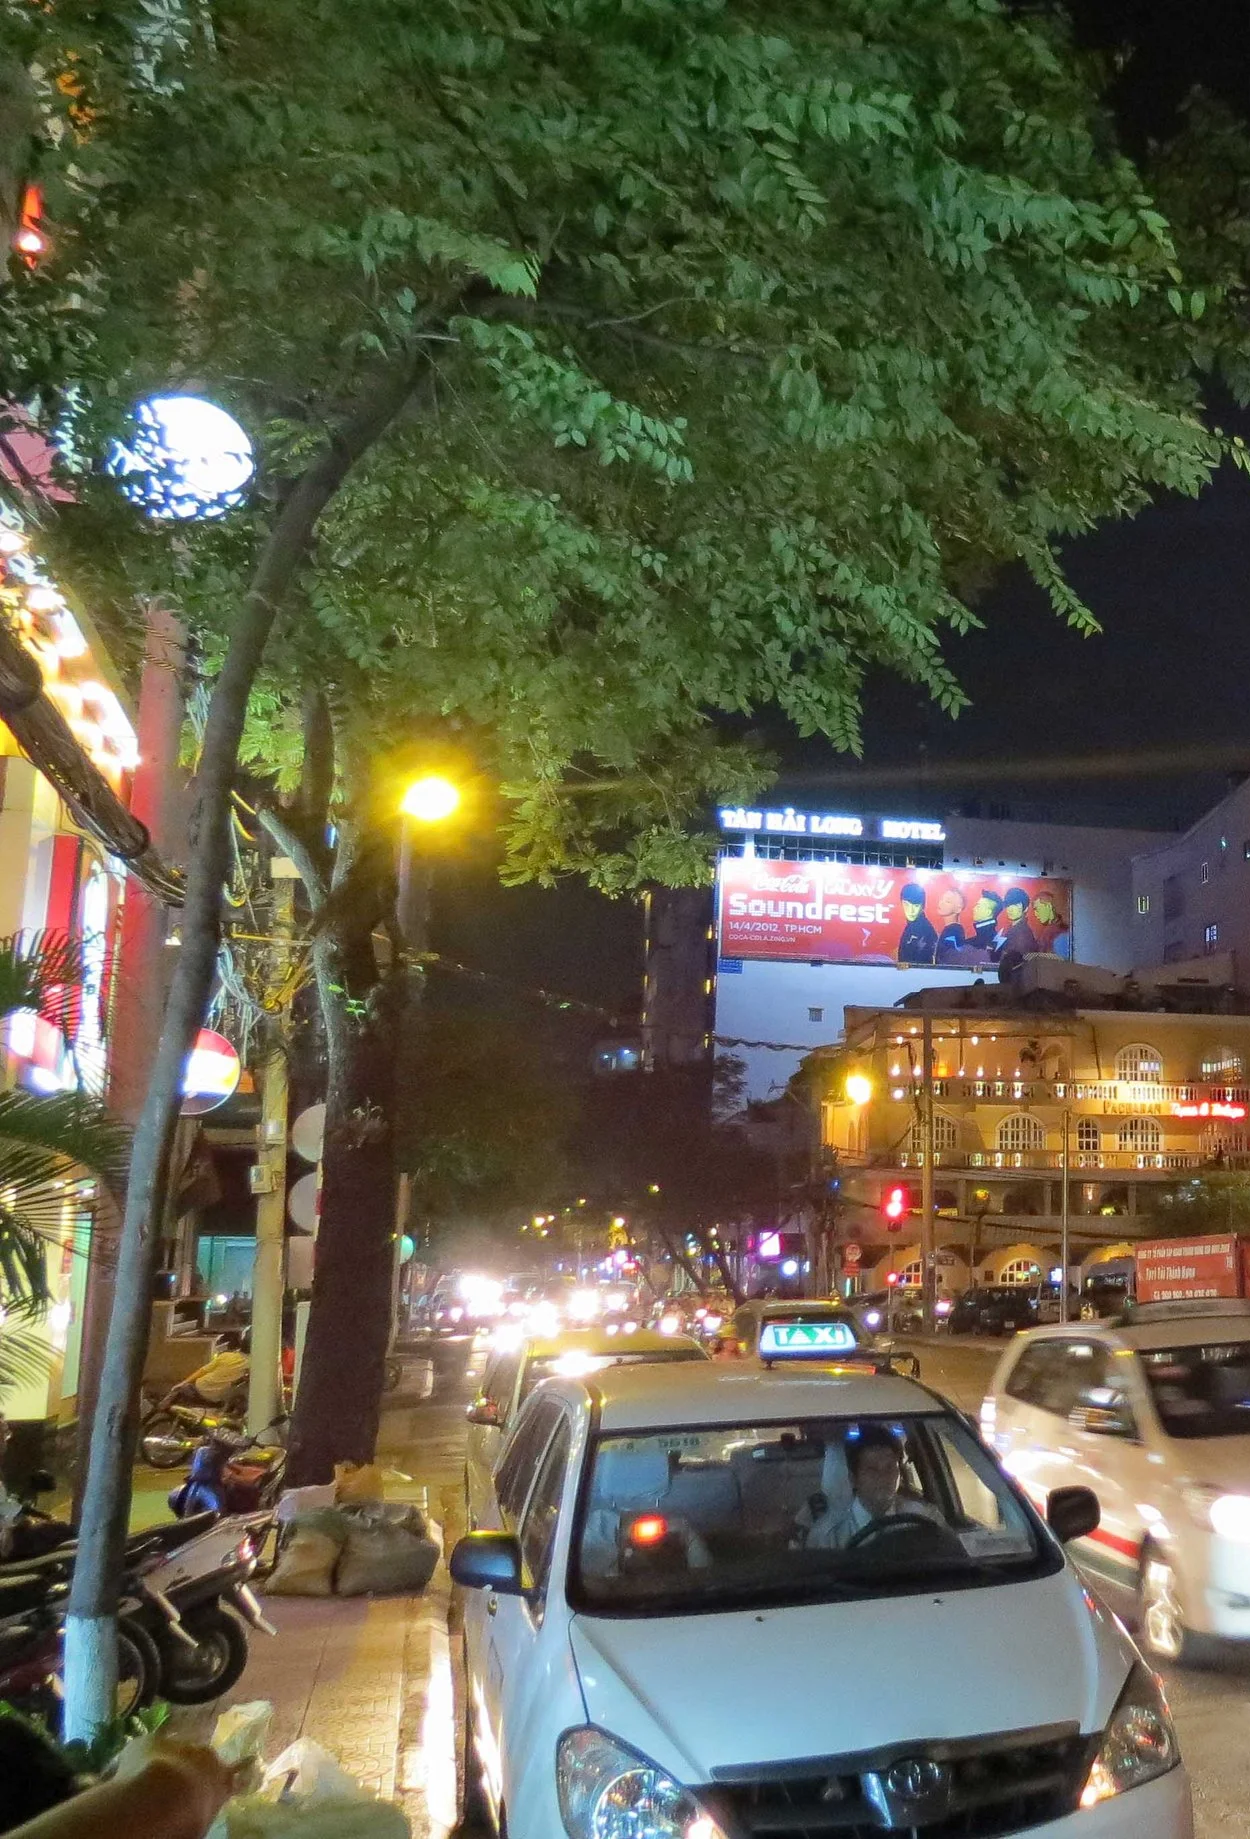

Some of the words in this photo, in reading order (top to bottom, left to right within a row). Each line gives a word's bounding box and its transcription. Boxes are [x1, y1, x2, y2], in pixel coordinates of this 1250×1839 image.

[810, 815, 863, 836] LONG
[882, 819, 946, 841] HOTEL
[729, 882, 890, 924] Soundfest
